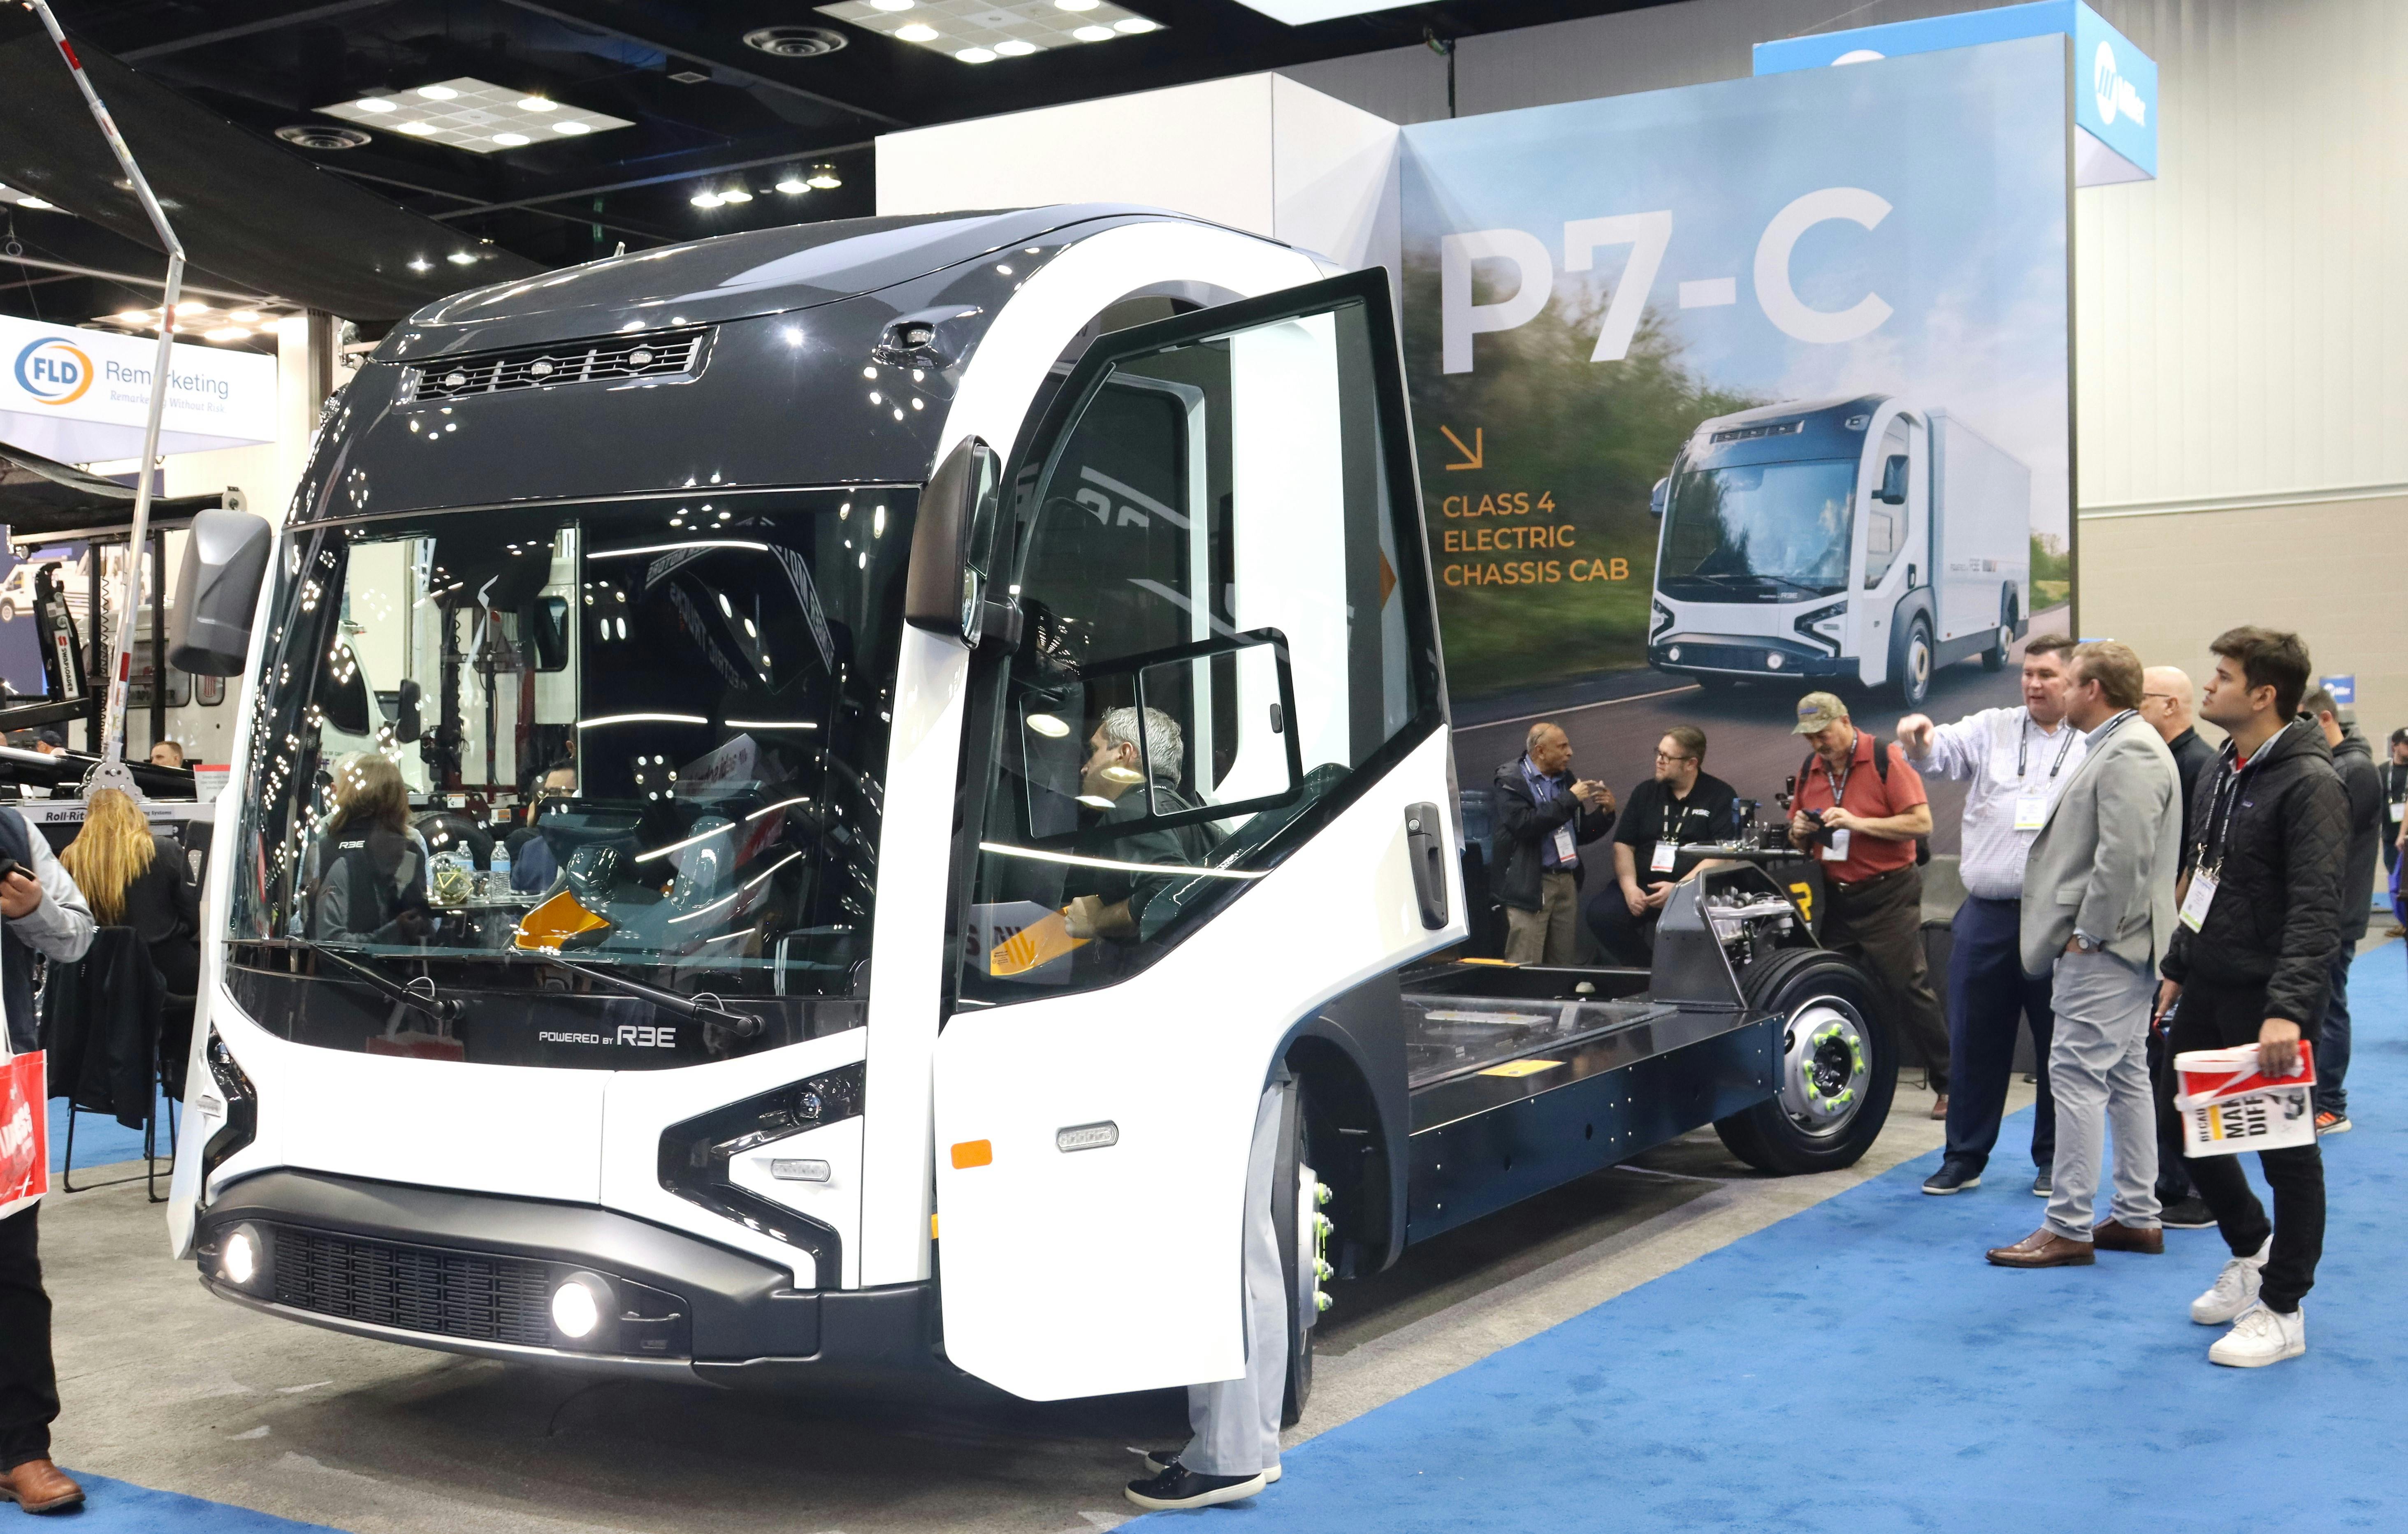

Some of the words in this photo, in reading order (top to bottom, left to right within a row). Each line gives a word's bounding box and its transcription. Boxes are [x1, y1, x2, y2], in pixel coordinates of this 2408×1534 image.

[1441, 186, 1894, 375] P7-C
[33, 356, 78, 385] FLD
[106, 360, 229, 399] Remrketing
[169, 397, 204, 411] Without
[1443, 492, 1530, 518] CLASS
[1537, 490, 1556, 513] 4
[1444, 524, 1576, 552] ELECTRIC
[1443, 560, 1562, 586] CHASSIS
[1568, 558, 1630, 582] CAB
[539, 1031, 599, 1044] POWERED
